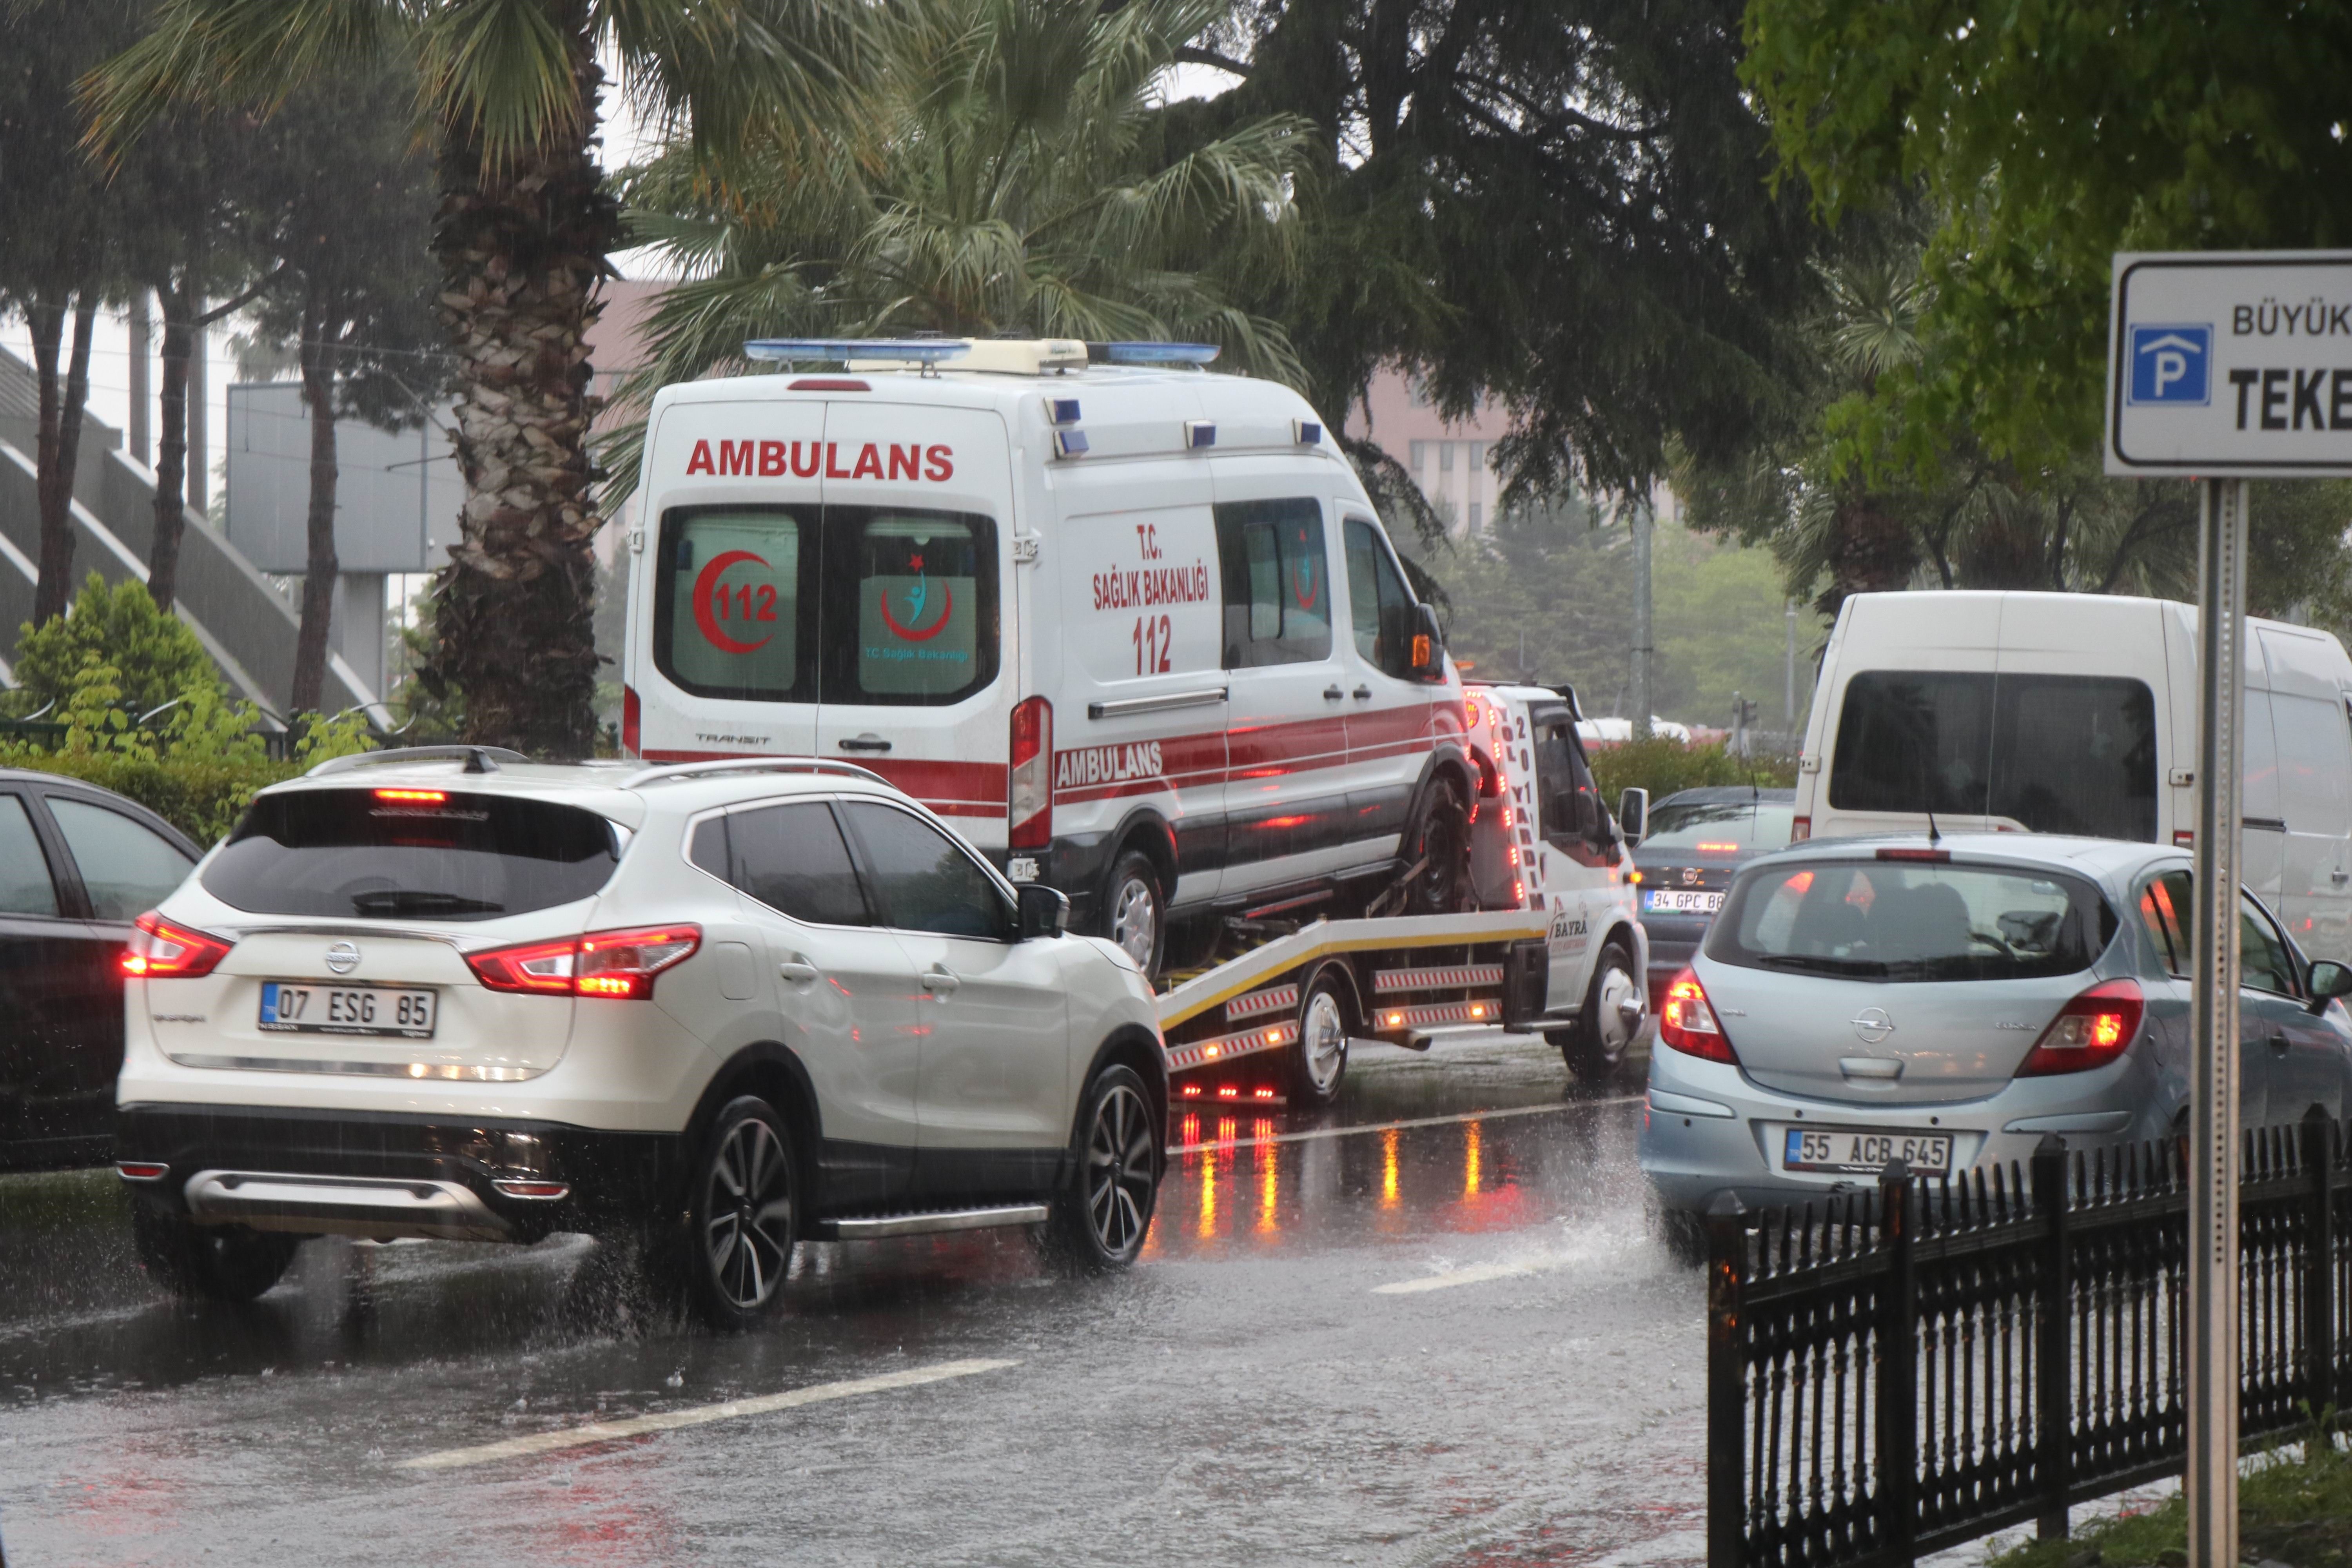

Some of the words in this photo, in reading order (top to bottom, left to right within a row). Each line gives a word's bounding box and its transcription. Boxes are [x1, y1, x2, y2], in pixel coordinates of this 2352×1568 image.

[2233, 297, 2352, 336] BÜYÜK
[2156, 352, 2186, 397] P
[2229, 369, 2352, 431] TEKE
[686, 439, 954, 482] AMBULANS
[1137, 523, 1162, 560] T.C.
[715, 583, 778, 622] 112
[1093, 563, 1142, 610] SAĞLIK
[1144, 557, 1209, 606] BAKANLIĞI
[1133, 614, 1171, 675] 112
[695, 733, 771, 745] TRANSIT
[1057, 740, 1163, 788] AMBULANS
[1511, 786, 1546, 911] YARDIM
[1653, 893, 1670, 908] 34
[1676, 893, 1702, 908] GPC
[279, 989, 309, 1020] 07
[329, 991, 375, 1023] ESG
[397, 995, 428, 1025] 85
[1802, 1134, 1831, 1160] 55
[1849, 1136, 1893, 1163] ACB
[1902, 1138, 1945, 1166] 645
